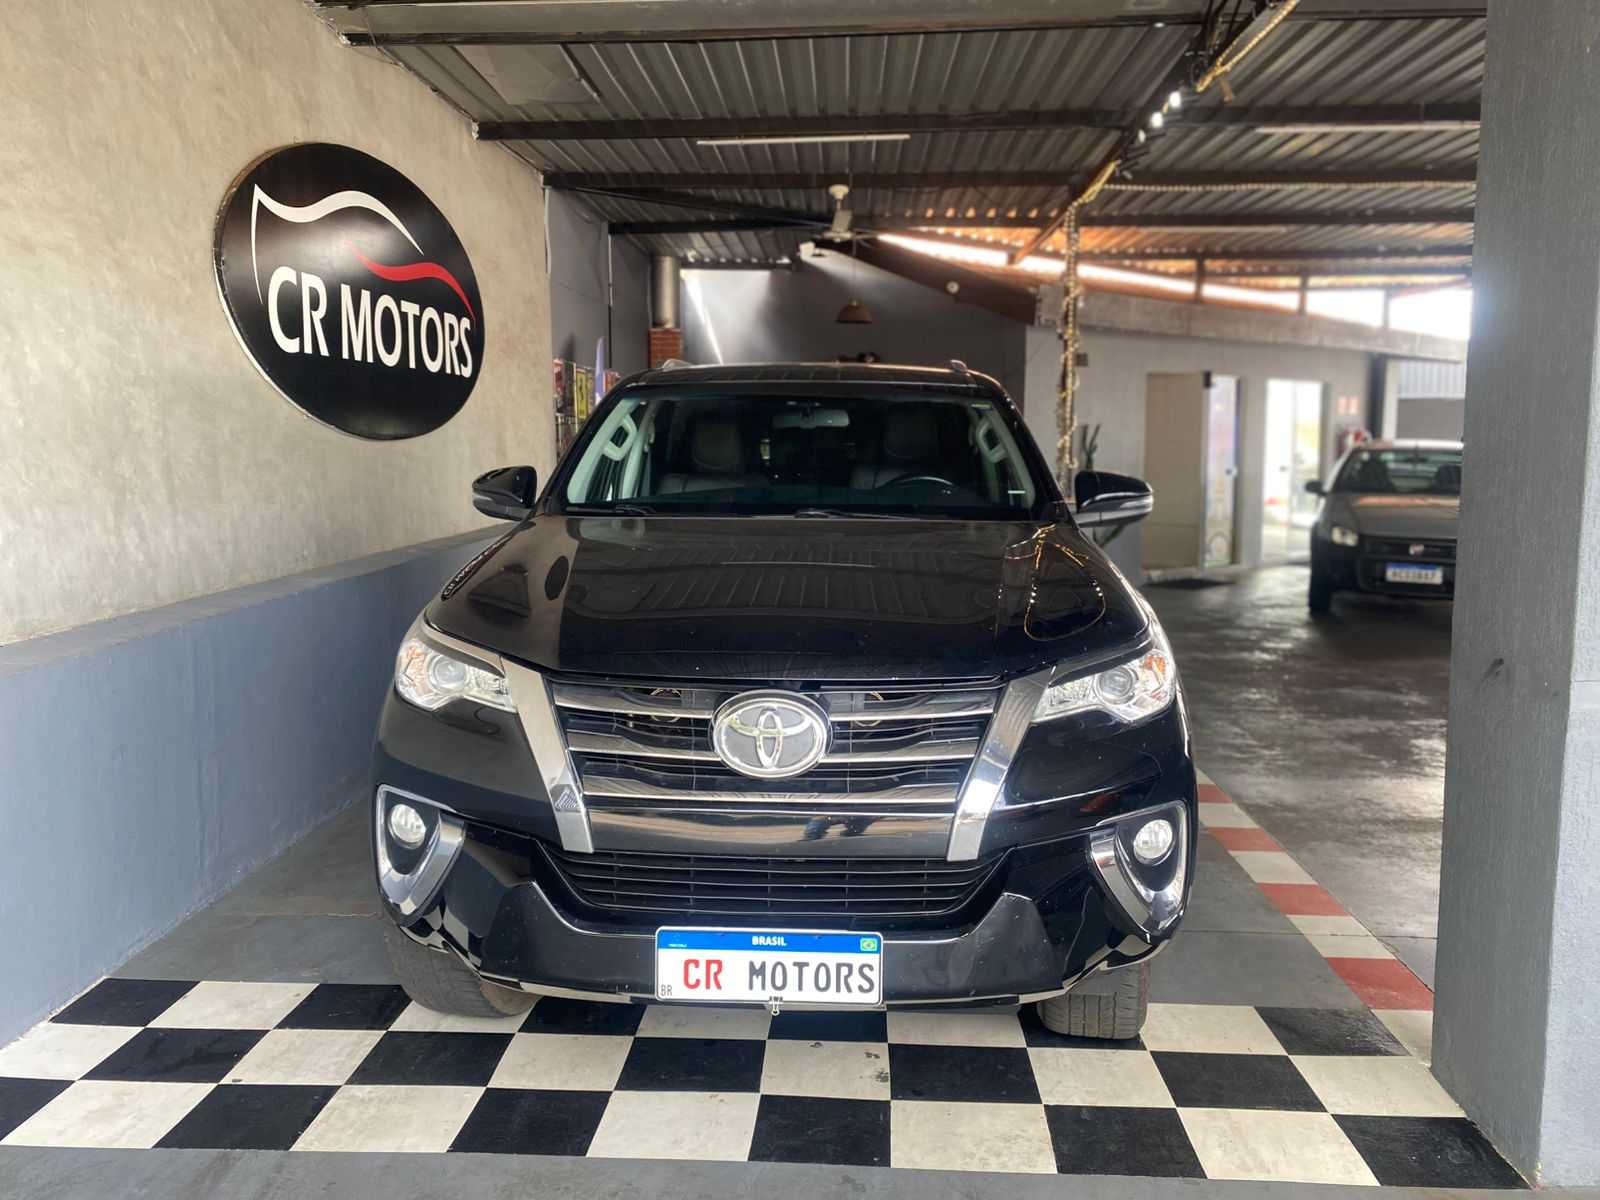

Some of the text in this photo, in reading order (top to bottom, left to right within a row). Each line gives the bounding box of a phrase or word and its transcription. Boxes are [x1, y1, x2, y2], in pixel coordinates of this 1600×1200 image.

[268, 266, 473, 378] CR MOTORS
[752, 936, 787, 946] BRASIL
[683, 959, 875, 993] CR MOTORS
[660, 984, 673, 997] BR
